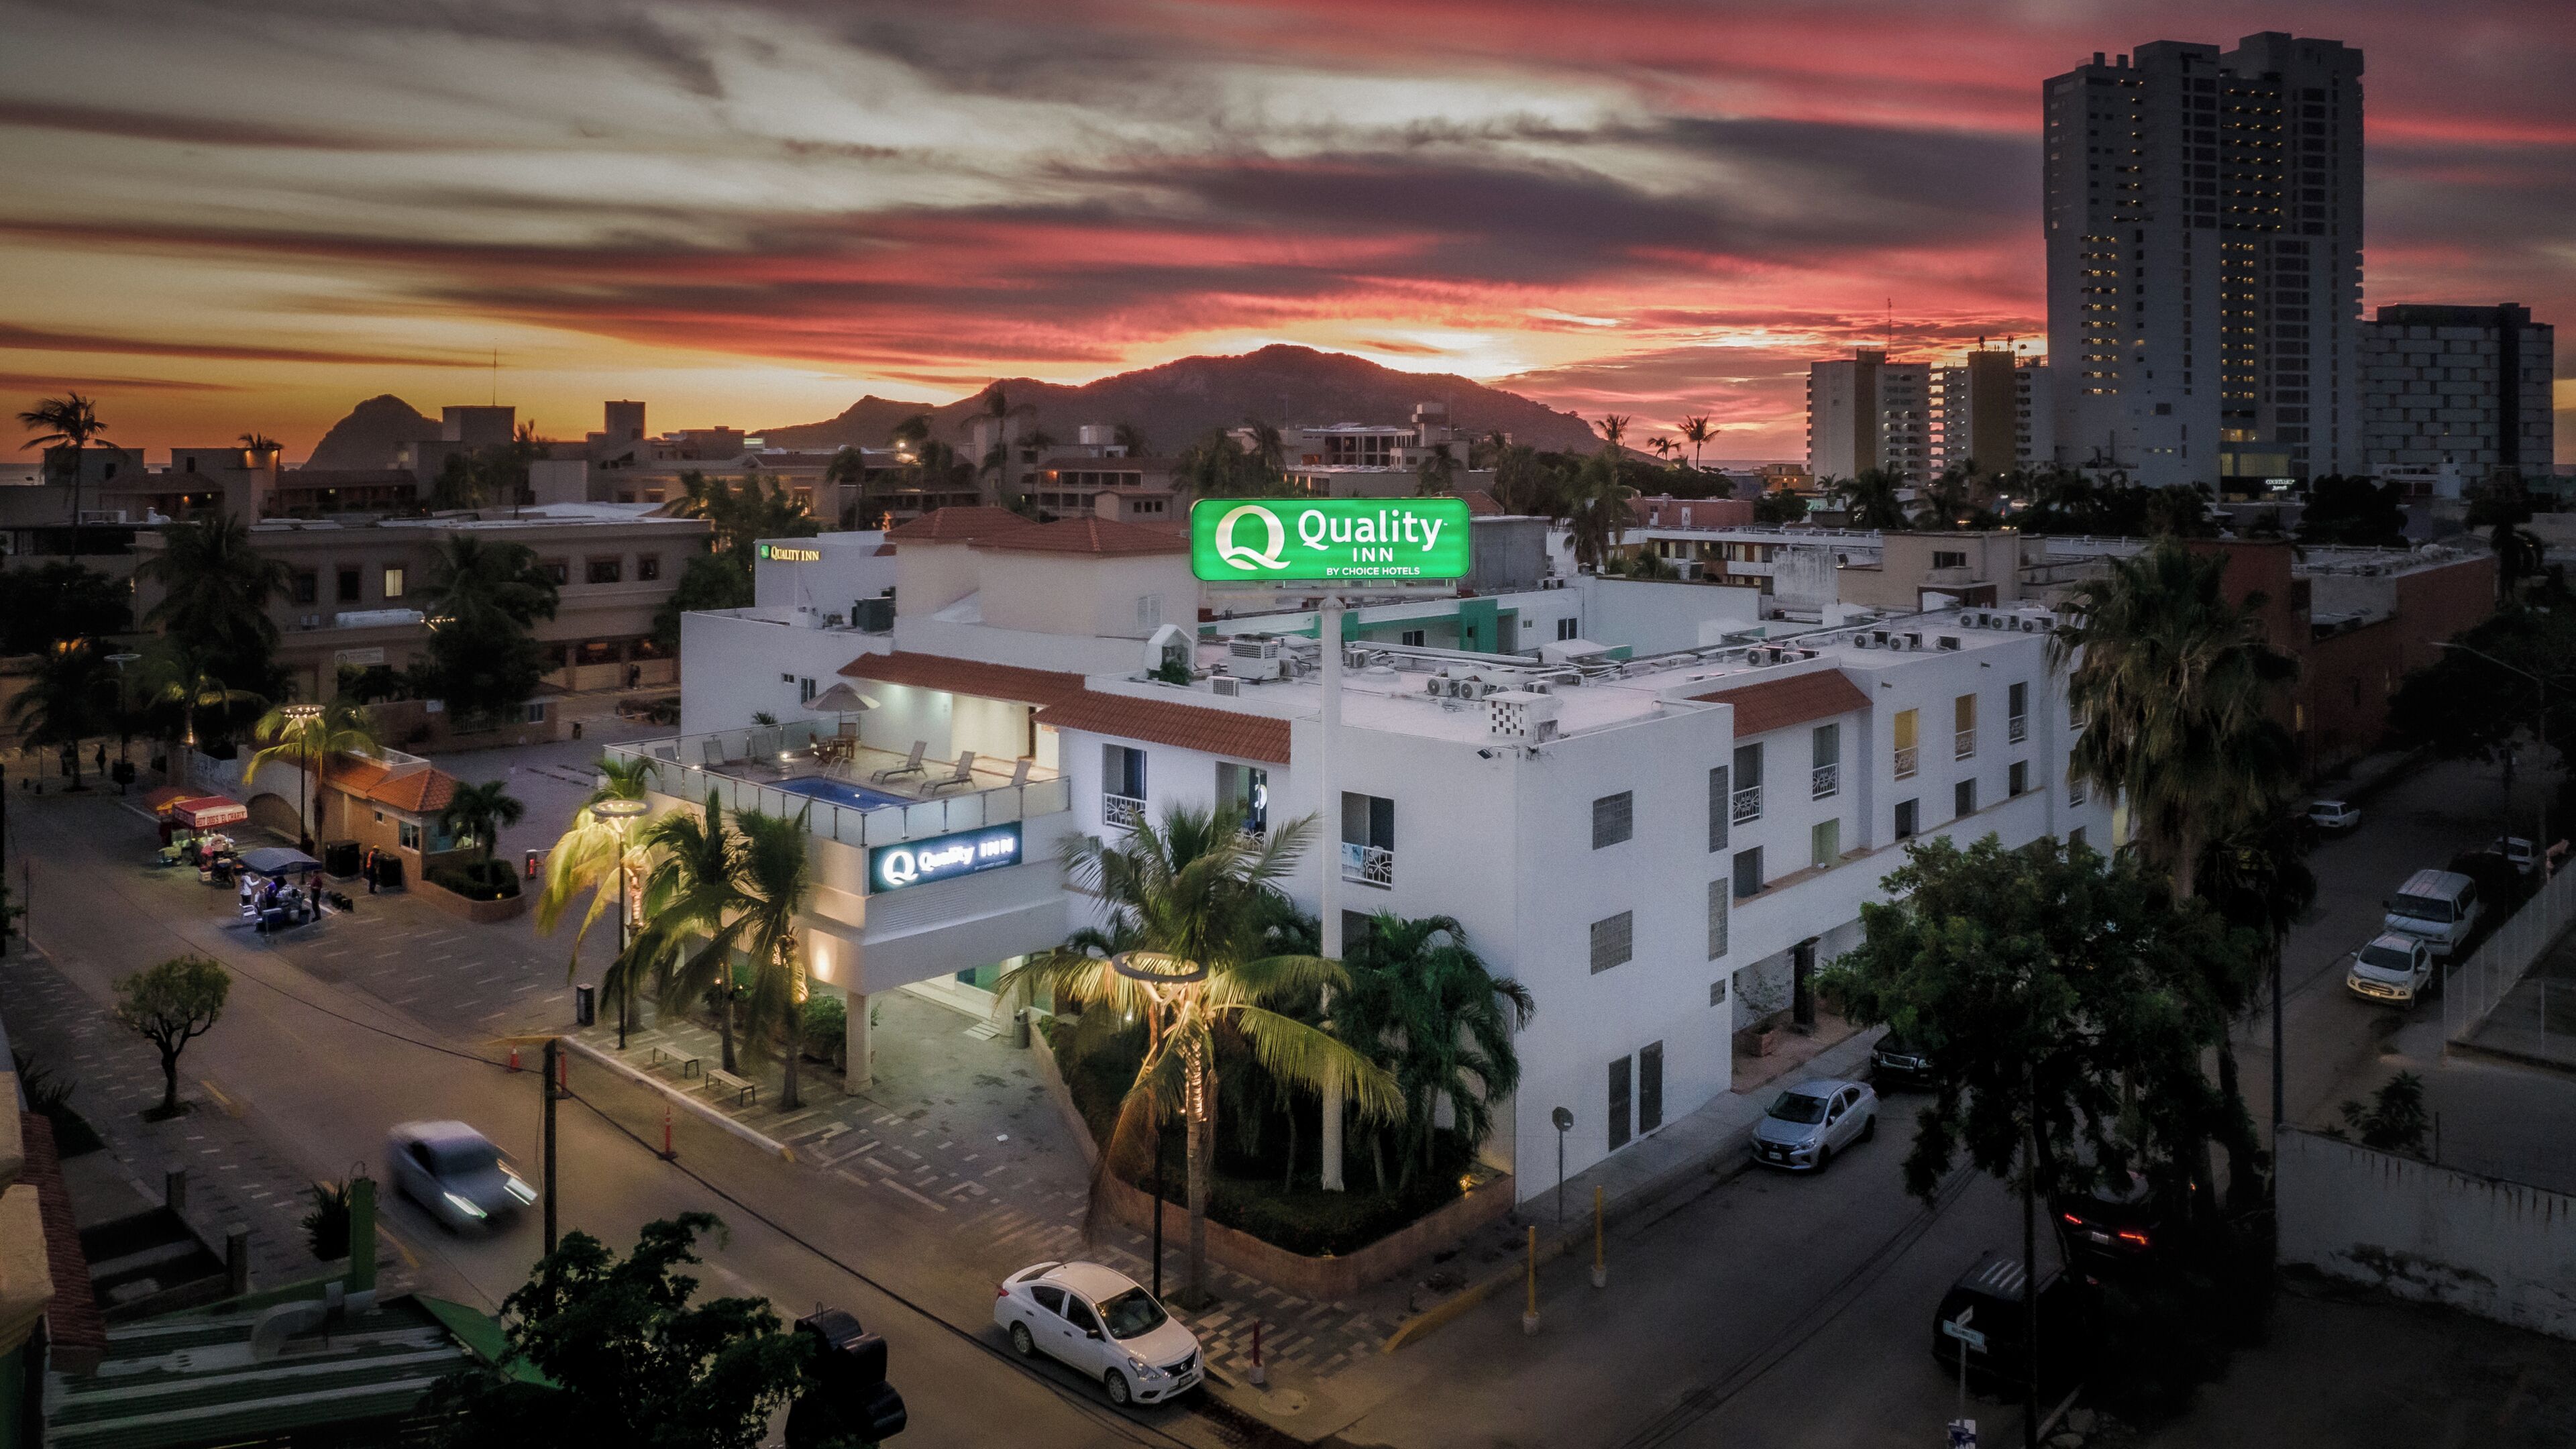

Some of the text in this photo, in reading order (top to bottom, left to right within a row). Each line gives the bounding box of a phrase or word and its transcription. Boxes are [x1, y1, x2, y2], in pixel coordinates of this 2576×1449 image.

[1298, 509, 1444, 551] Quality
[771, 546, 819, 561] QUALITY INN
[1352, 547, 1393, 562] INN
[1326, 566, 1420, 576] BY CHOICE HOTELS
[979, 837, 1014, 857] INN
